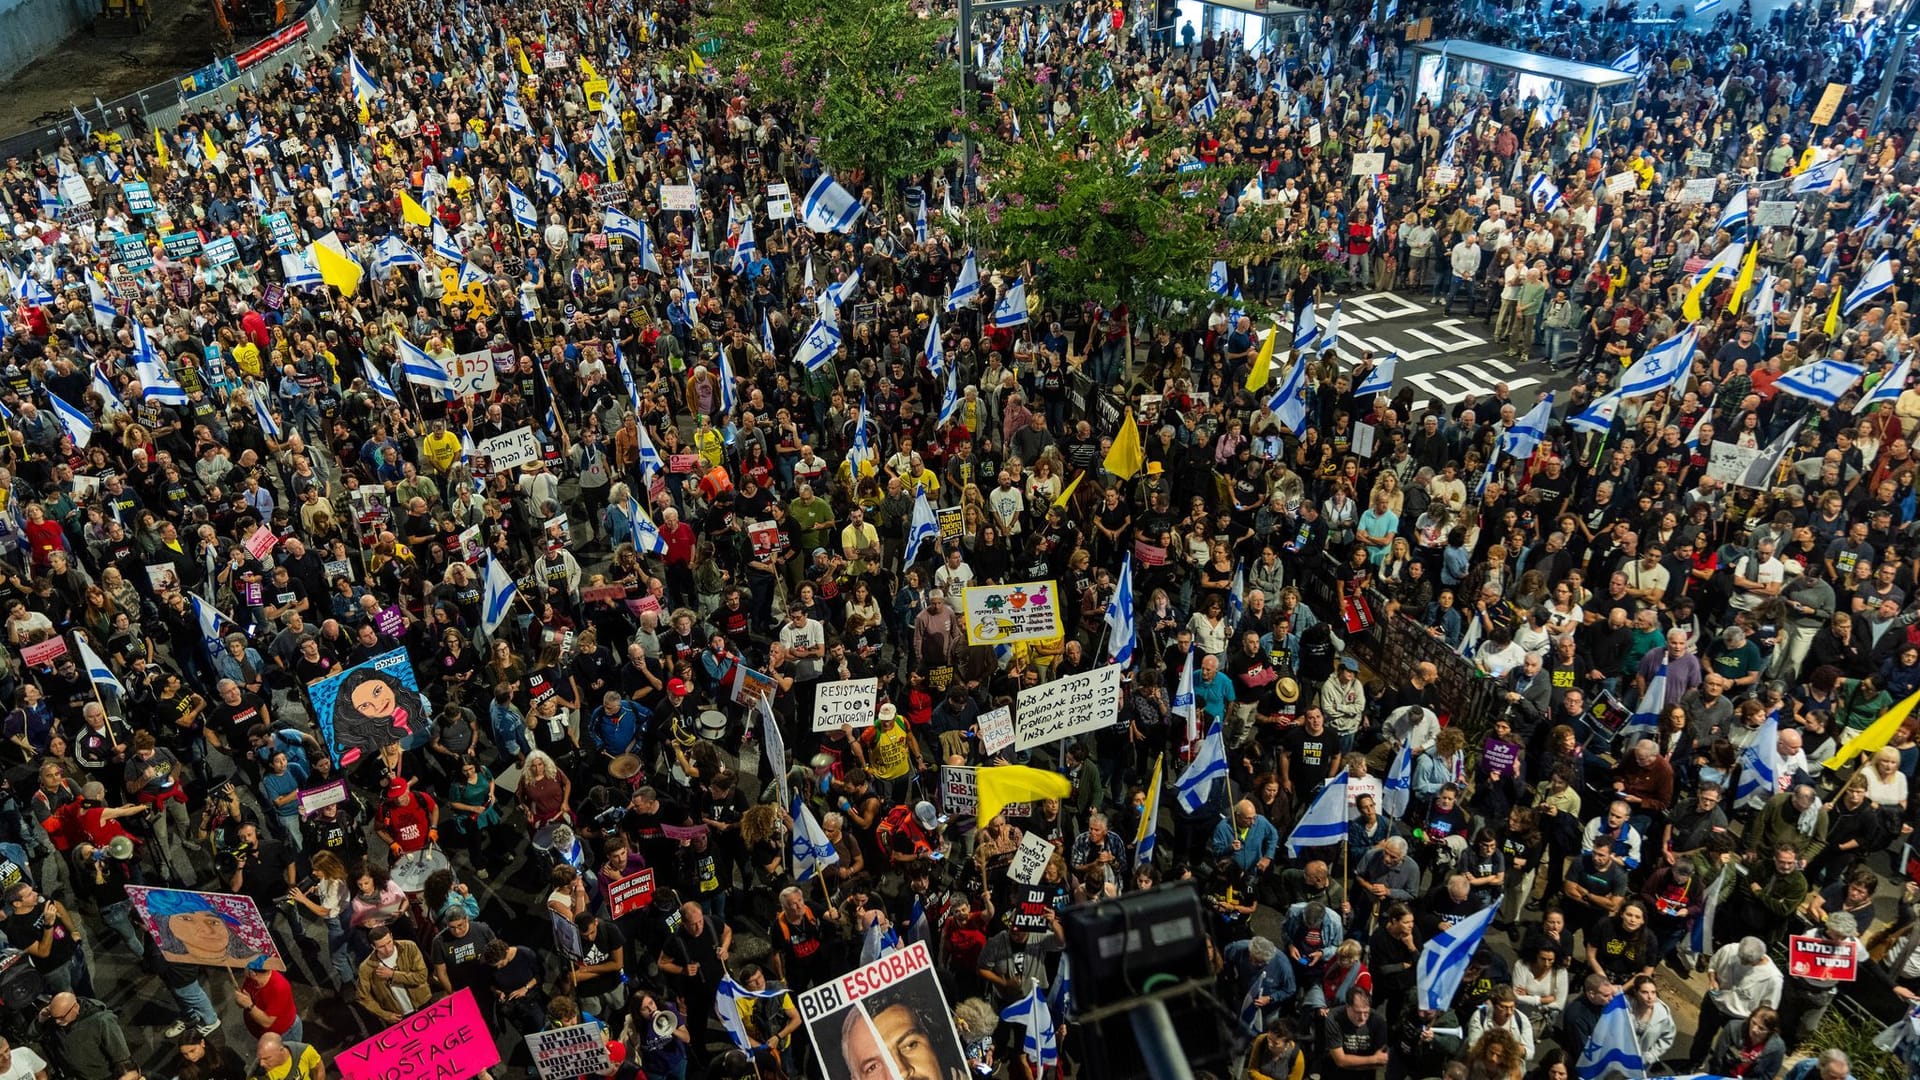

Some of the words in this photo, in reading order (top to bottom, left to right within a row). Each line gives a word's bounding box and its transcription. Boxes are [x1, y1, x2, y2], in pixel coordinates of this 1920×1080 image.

[517, 432, 531, 447] אין
[524, 445, 535, 457] על
[530, 674, 544, 687] עם
[821, 684, 877, 698] RESISTANCE
[1038, 688, 1055, 702] את
[1097, 685, 1115, 697] כדי
[1016, 696, 1037, 711] עצמו
[1051, 698, 1066, 710] את
[817, 711, 874, 727] DICTATORSHIP
[979, 708, 1008, 724] LIVES
[1052, 710, 1066, 721] את
[1096, 708, 1114, 720] כדי
[984, 725, 1012, 742] DEALS
[1023, 727, 1046, 742] עצמו
[1046, 720, 1065, 735] את
[1019, 843, 1046, 863] למלחמה
[1036, 841, 1046, 852] די
[1021, 855, 1041, 870] STOP
[1022, 864, 1033, 875] THE
[1014, 868, 1032, 886] WAR
[1028, 890, 1045, 902] עם
[801, 983, 843, 1020] BIBI
[842, 944, 929, 1001] ESCOBAR
[352, 997, 454, 1061] VICTORY
[540, 1027, 585, 1043] נתניהו
[584, 1048, 605, 1058] את
